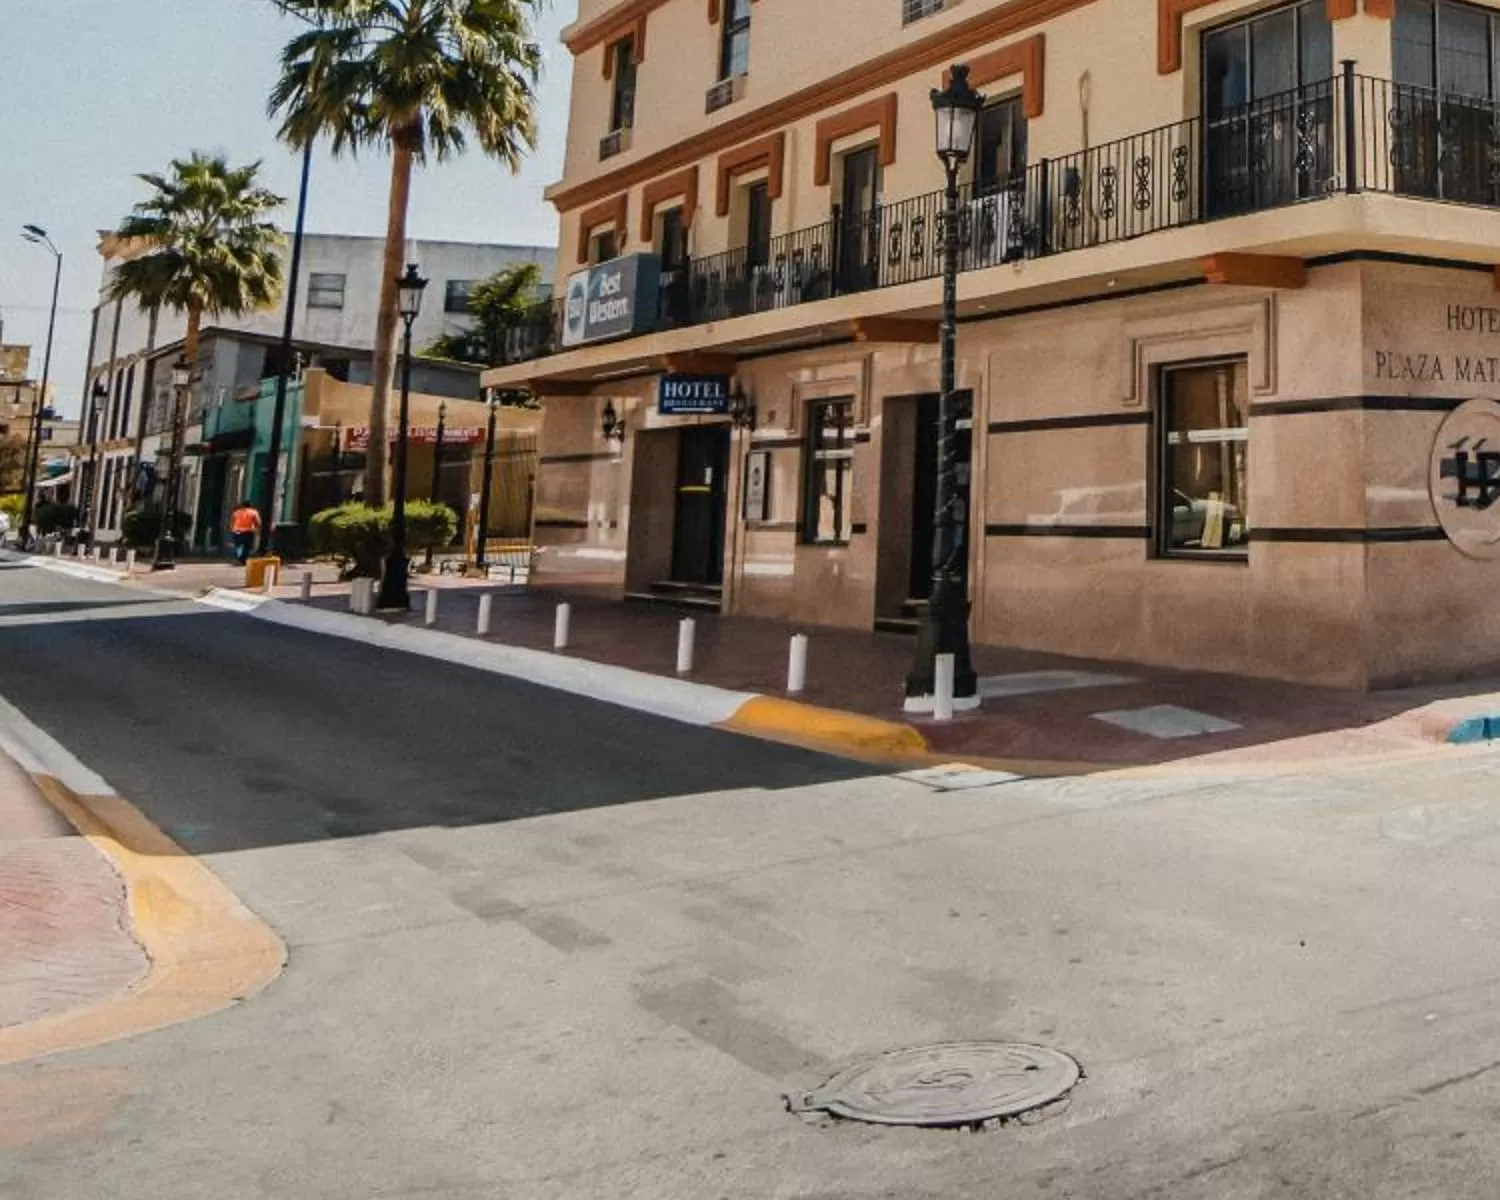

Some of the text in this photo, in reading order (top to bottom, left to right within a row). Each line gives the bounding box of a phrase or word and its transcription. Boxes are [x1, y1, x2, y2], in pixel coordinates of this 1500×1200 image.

[600, 272, 621, 297] Best
[589, 297, 629, 324] Western
[1375, 350, 1444, 381] PLAZA
[664, 381, 725, 399] HOTEL
